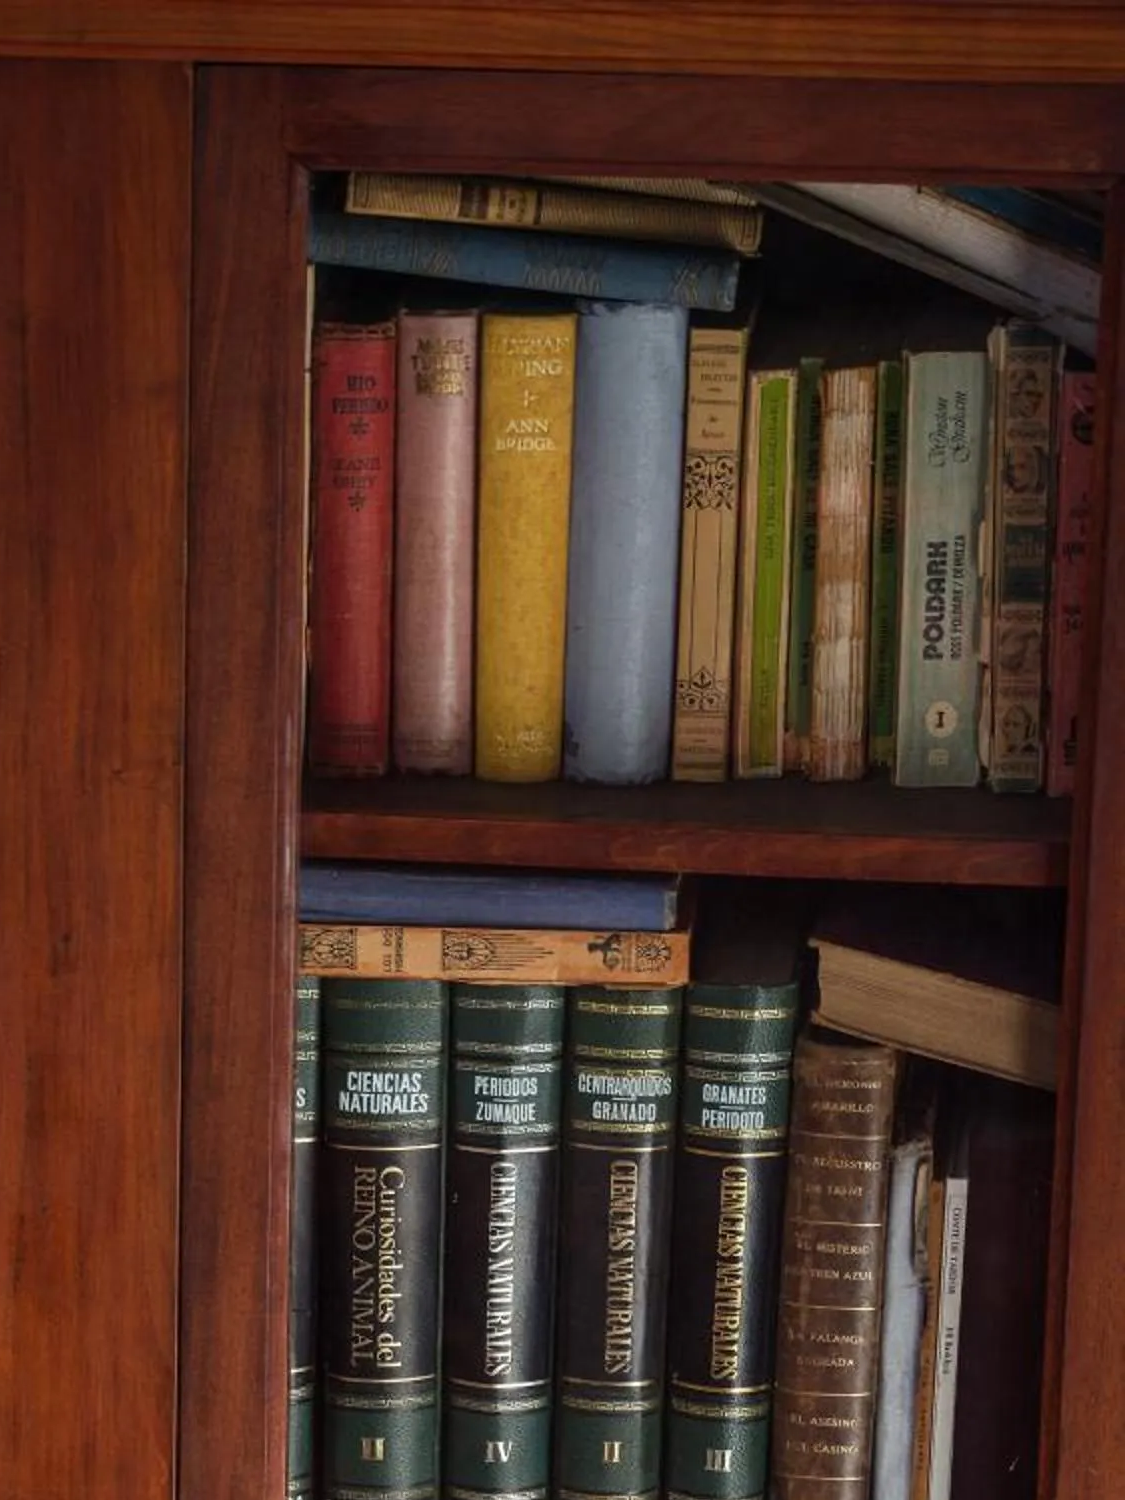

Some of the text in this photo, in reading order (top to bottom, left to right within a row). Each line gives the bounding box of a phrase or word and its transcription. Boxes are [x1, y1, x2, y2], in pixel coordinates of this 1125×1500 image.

[506, 418, 549, 433] ANN
[923, 541, 948, 661] POLDARK
[346, 1070, 422, 1095] CIENCIAS
[475, 1075, 539, 1098] PERIODOS
[702, 1082, 767, 1106] GRANATES
[339, 1091, 429, 1116] NATURALES
[475, 1099, 536, 1124] ZUMAQUE
[592, 1100, 658, 1123] GRANADO
[701, 1107, 766, 1130] PERIDOTO
[351, 1166, 377, 1369] REINO ANIMAL
[377, 1165, 406, 1369] Curiosidades del
[485, 1160, 516, 1378] CIENCIAS NATURALES
[603, 1159, 637, 1377] CIENCIAS NATURALES
[710, 1164, 749, 1380] CIENCIAS NATURALES
[484, 1440, 514, 1463] IV
[704, 1448, 733, 1472] III
